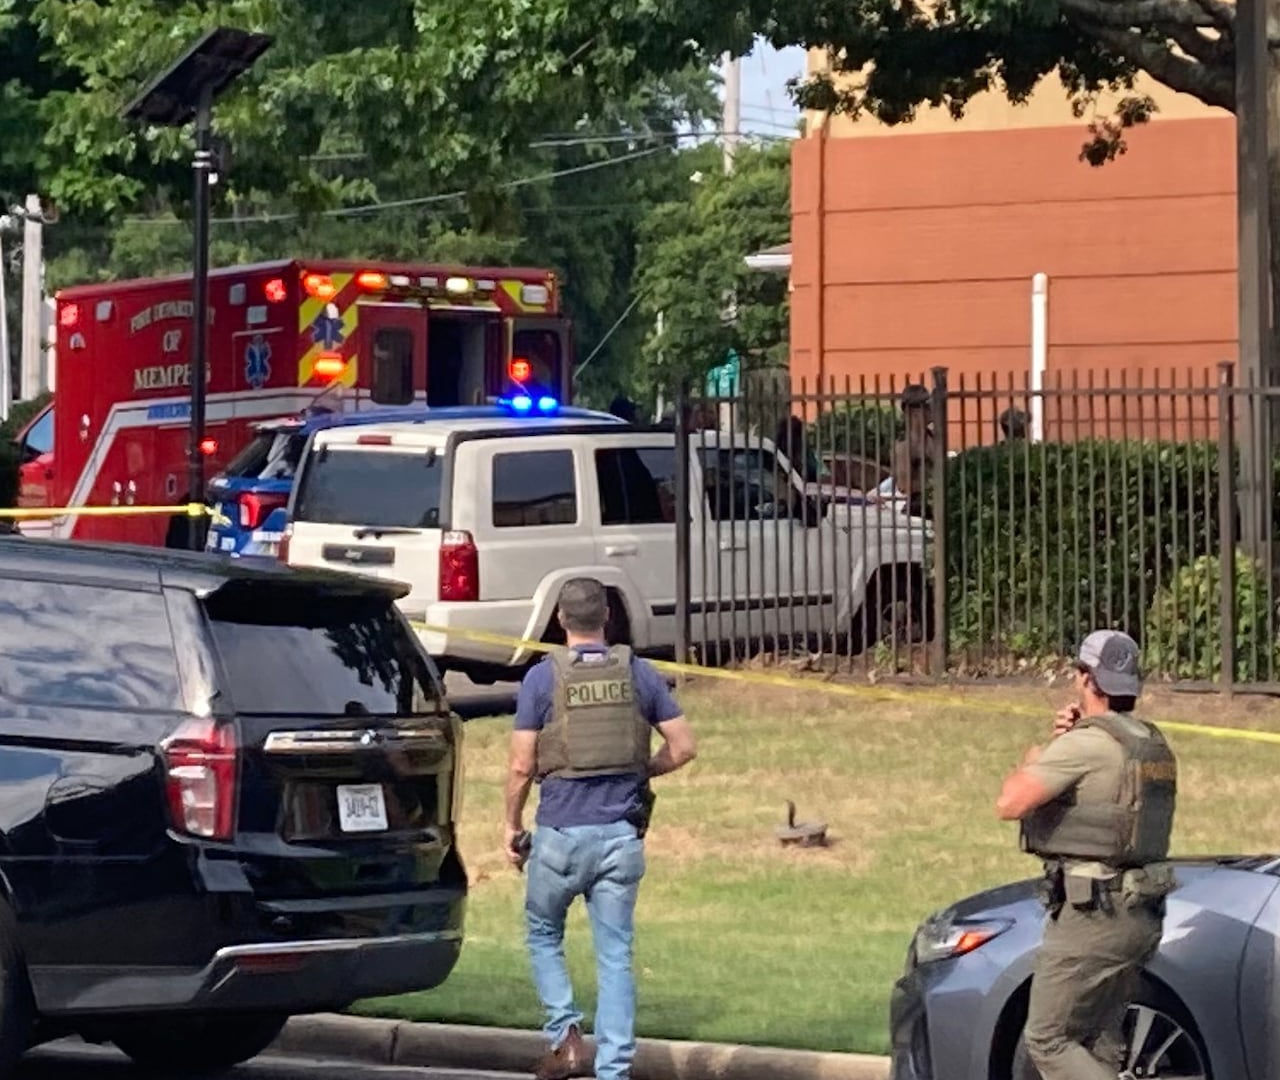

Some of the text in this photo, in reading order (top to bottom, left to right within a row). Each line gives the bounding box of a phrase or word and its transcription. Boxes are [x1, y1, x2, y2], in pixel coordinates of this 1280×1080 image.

[162, 328, 183, 353] OF
[133, 362, 212, 391] MEMPHS
[565, 682, 631, 704] POLICE
